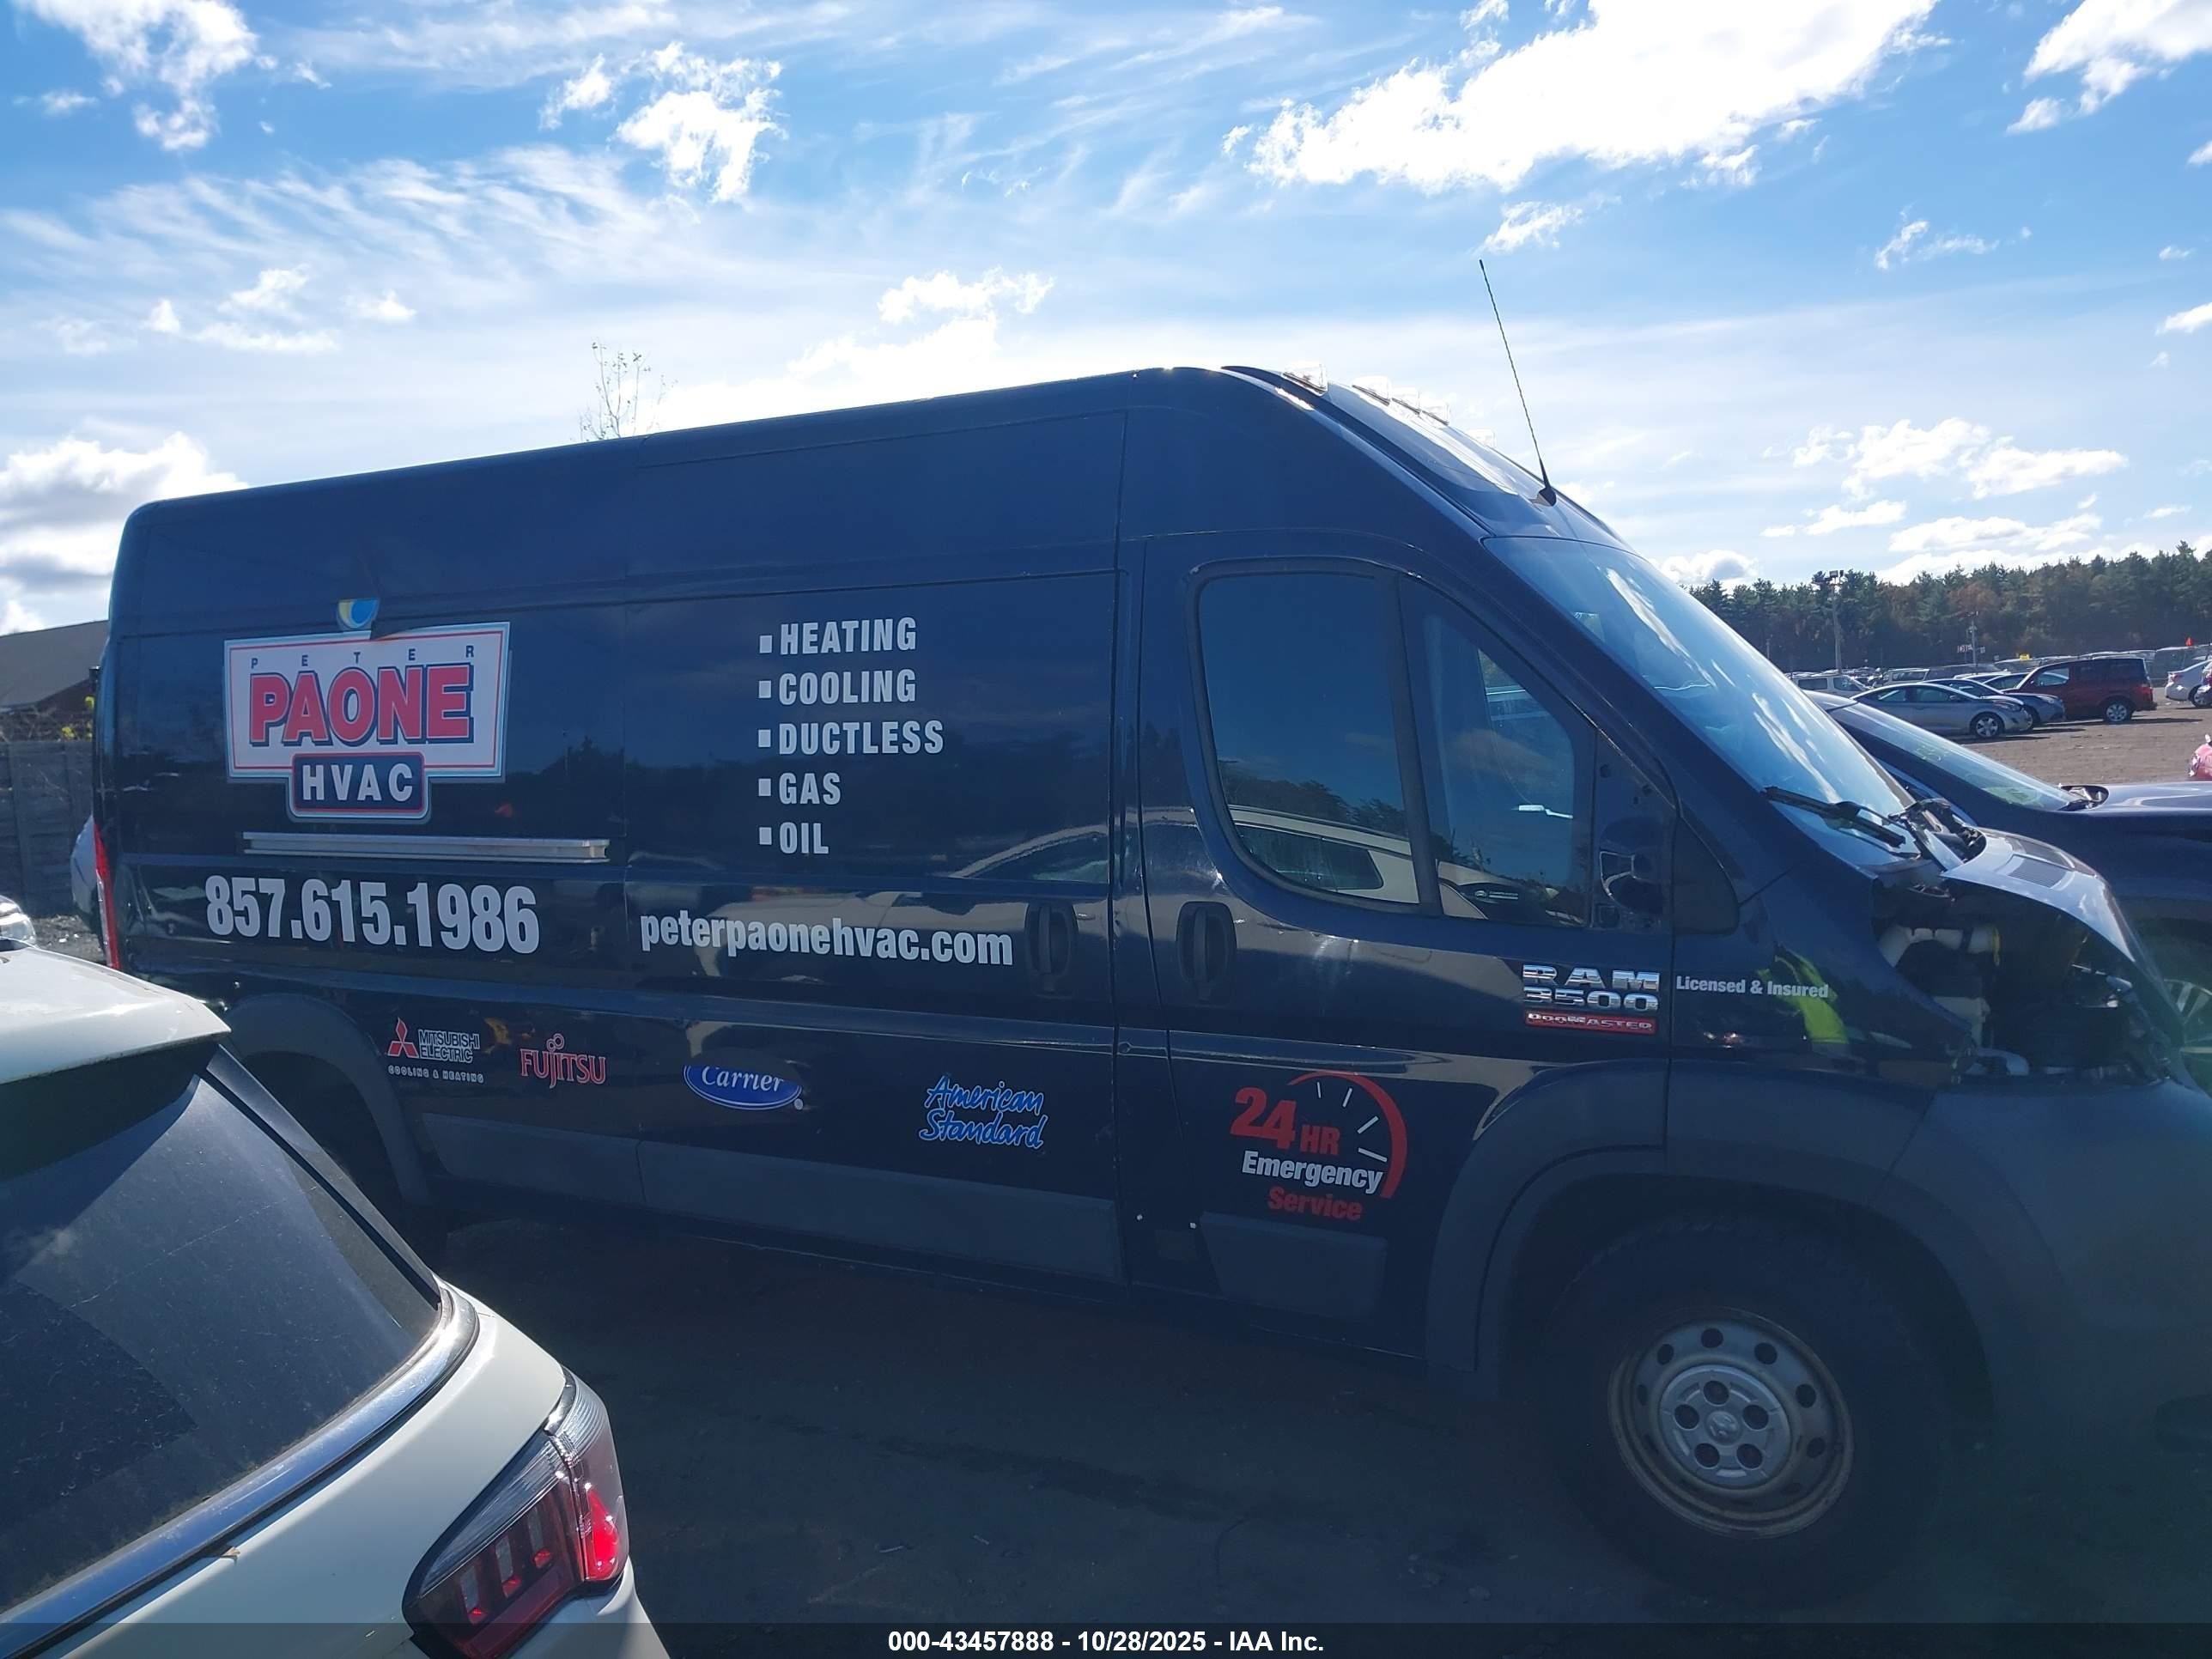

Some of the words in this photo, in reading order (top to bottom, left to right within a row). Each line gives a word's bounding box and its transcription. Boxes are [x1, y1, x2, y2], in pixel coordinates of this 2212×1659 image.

[780, 617, 917, 655] HEATING
[251, 646, 475, 669] PETER
[249, 662, 475, 747] PAONE
[779, 669, 917, 705] COOLING
[779, 720, 944, 755] DUCTLESS
[302, 763, 413, 802] HVAC
[779, 772, 842, 805] GAS
[779, 822, 830, 854] OIL
[204, 875, 540, 954] 857.615.1986
[640, 909, 1014, 965] peterpaonehvac.com
[1522, 964, 1661, 992] RAM
[1676, 975, 1746, 994] Licensed
[1750, 981, 1763, 994] &
[1767, 981, 1829, 998] Insured
[1523, 986, 1659, 1012] 3500
[417, 1029, 481, 1049] MITSUBISHI
[419, 1044, 474, 1064] ELECTRIC
[388, 1065, 429, 1079] COOLING
[433, 1069, 440, 1079] &
[442, 1070, 484, 1084] HEATING
[924, 1075, 1044, 1116] American
[919, 1108, 1048, 1149] Standard
[1231, 1087, 1297, 1149] 24
[1299, 1124, 1340, 1155] HR
[1242, 1150, 1384, 1194] Emergency
[1267, 1186, 1363, 1220] Service
